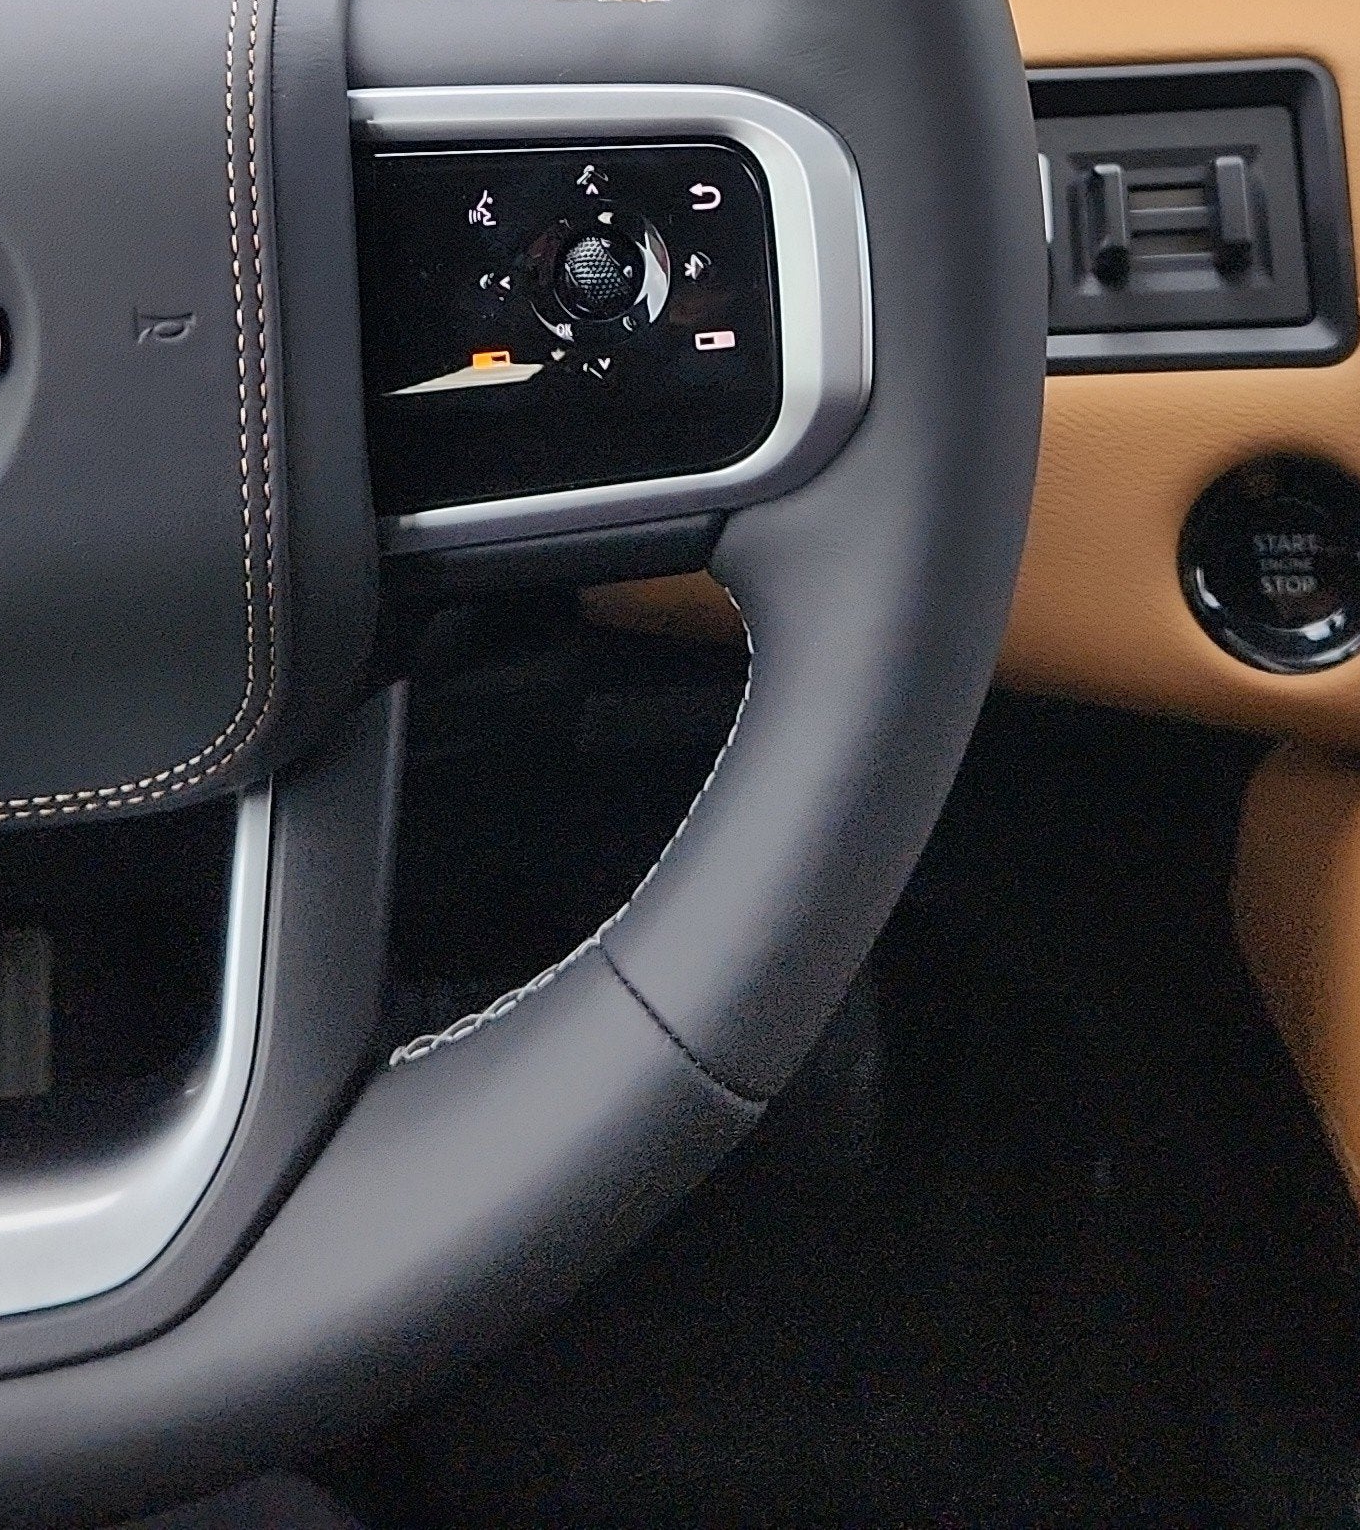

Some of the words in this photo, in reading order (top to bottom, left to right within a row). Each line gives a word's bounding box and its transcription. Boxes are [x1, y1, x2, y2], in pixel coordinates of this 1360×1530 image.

[556, 323, 573, 337] OK
[1253, 533, 1324, 553] START
[1261, 575, 1317, 593] STOP
